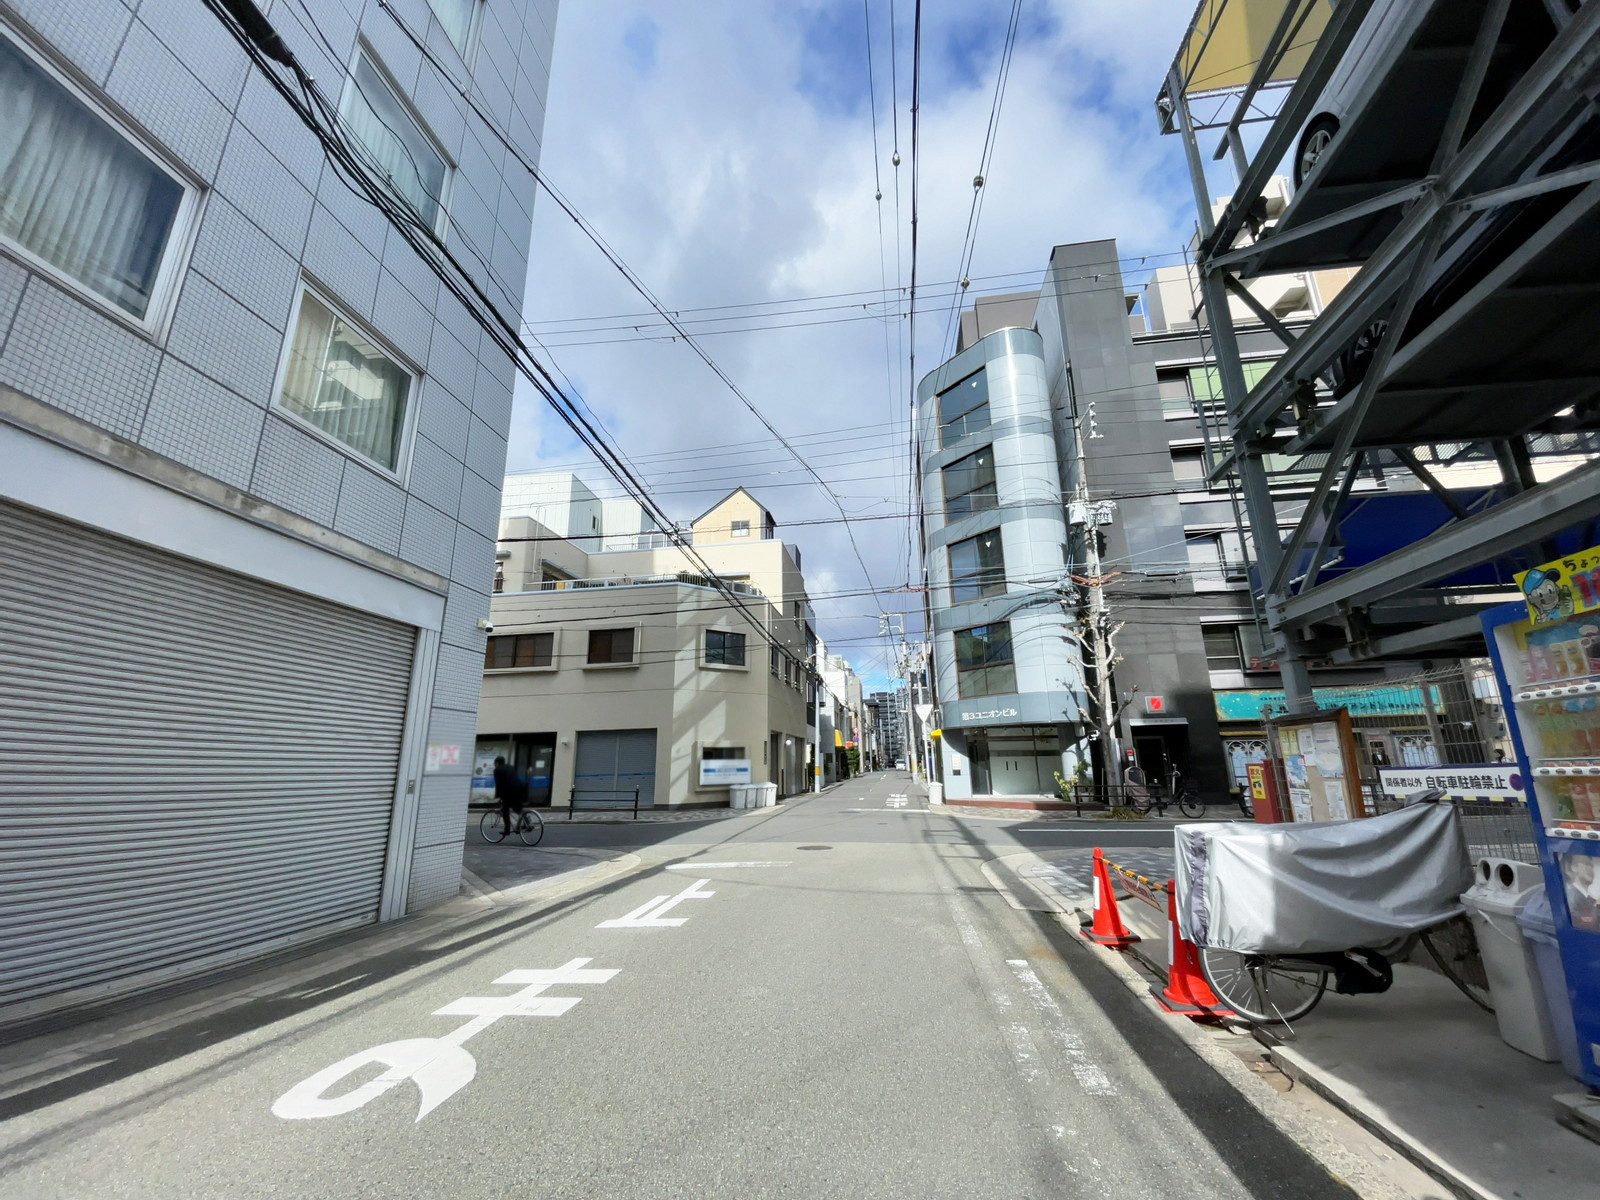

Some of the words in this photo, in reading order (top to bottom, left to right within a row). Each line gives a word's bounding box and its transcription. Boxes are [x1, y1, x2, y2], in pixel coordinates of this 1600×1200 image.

[1385, 777, 1423, 788] 関係者以外
[1425, 775, 1508, 791] 自転車駐輪禁止
